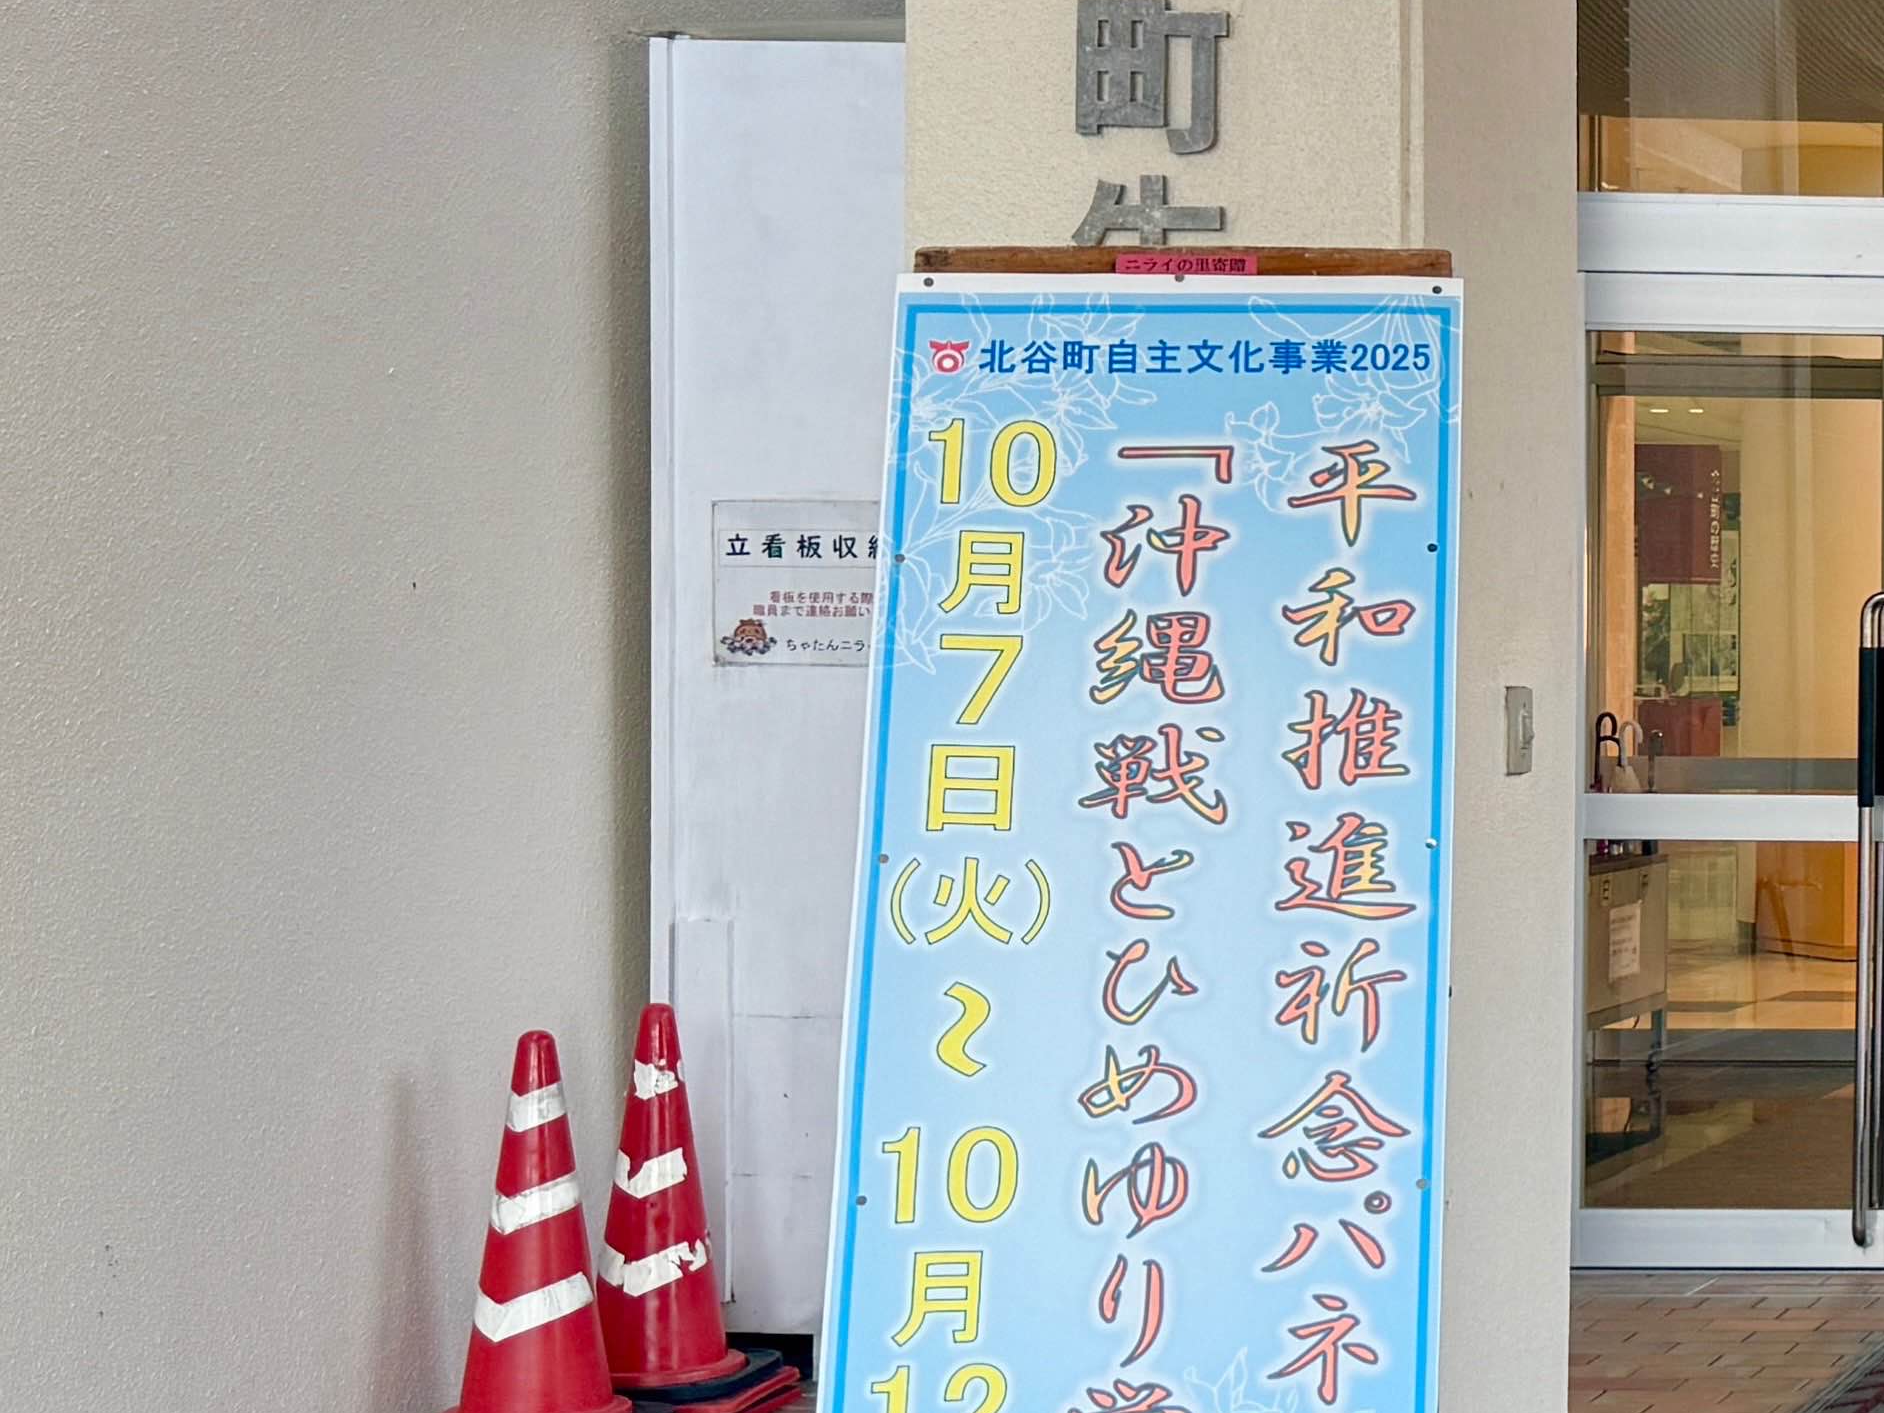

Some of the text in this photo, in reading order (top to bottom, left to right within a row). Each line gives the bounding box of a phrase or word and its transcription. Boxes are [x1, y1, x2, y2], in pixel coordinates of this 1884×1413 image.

[979, 337, 1430, 375] 北谷町自主文化事業2025
[786, 639, 870, 651] ちゃたんニラ
